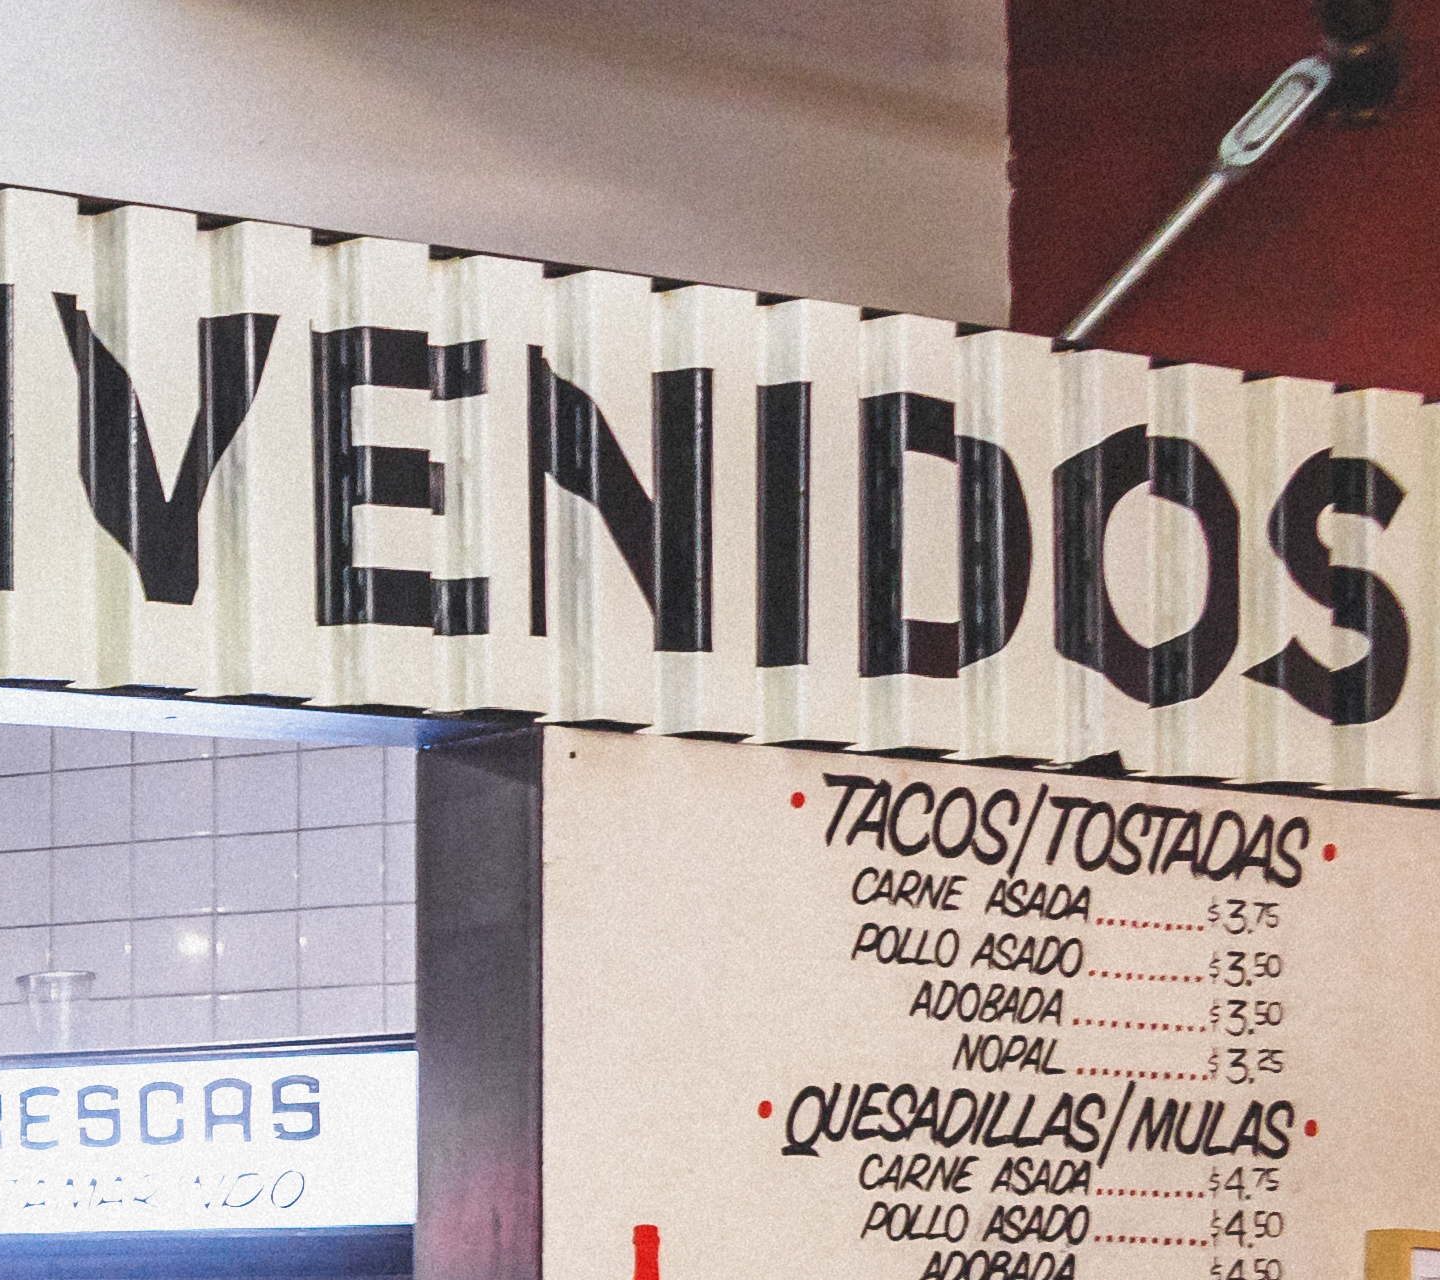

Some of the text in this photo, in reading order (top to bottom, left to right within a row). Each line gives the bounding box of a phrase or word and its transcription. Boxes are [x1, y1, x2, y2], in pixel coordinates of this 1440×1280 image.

[820, 772, 1312, 889] TACOS/TOSTADAS
[851, 866, 1282, 936] CARNE ASADA $3.75
[851, 922, 1284, 988] POLLO ASADO $3.50
[909, 980, 1285, 1037] ADOBADA $3.50
[953, 1033, 1285, 1085] NOPAL $3.25
[780, 1080, 1297, 1166] QUESADILLAS/MULAS
[857, 1156, 1281, 1203] CARNE ASADA $4.75
[860, 1203, 1285, 1250] POLLO ASADO $4.50
